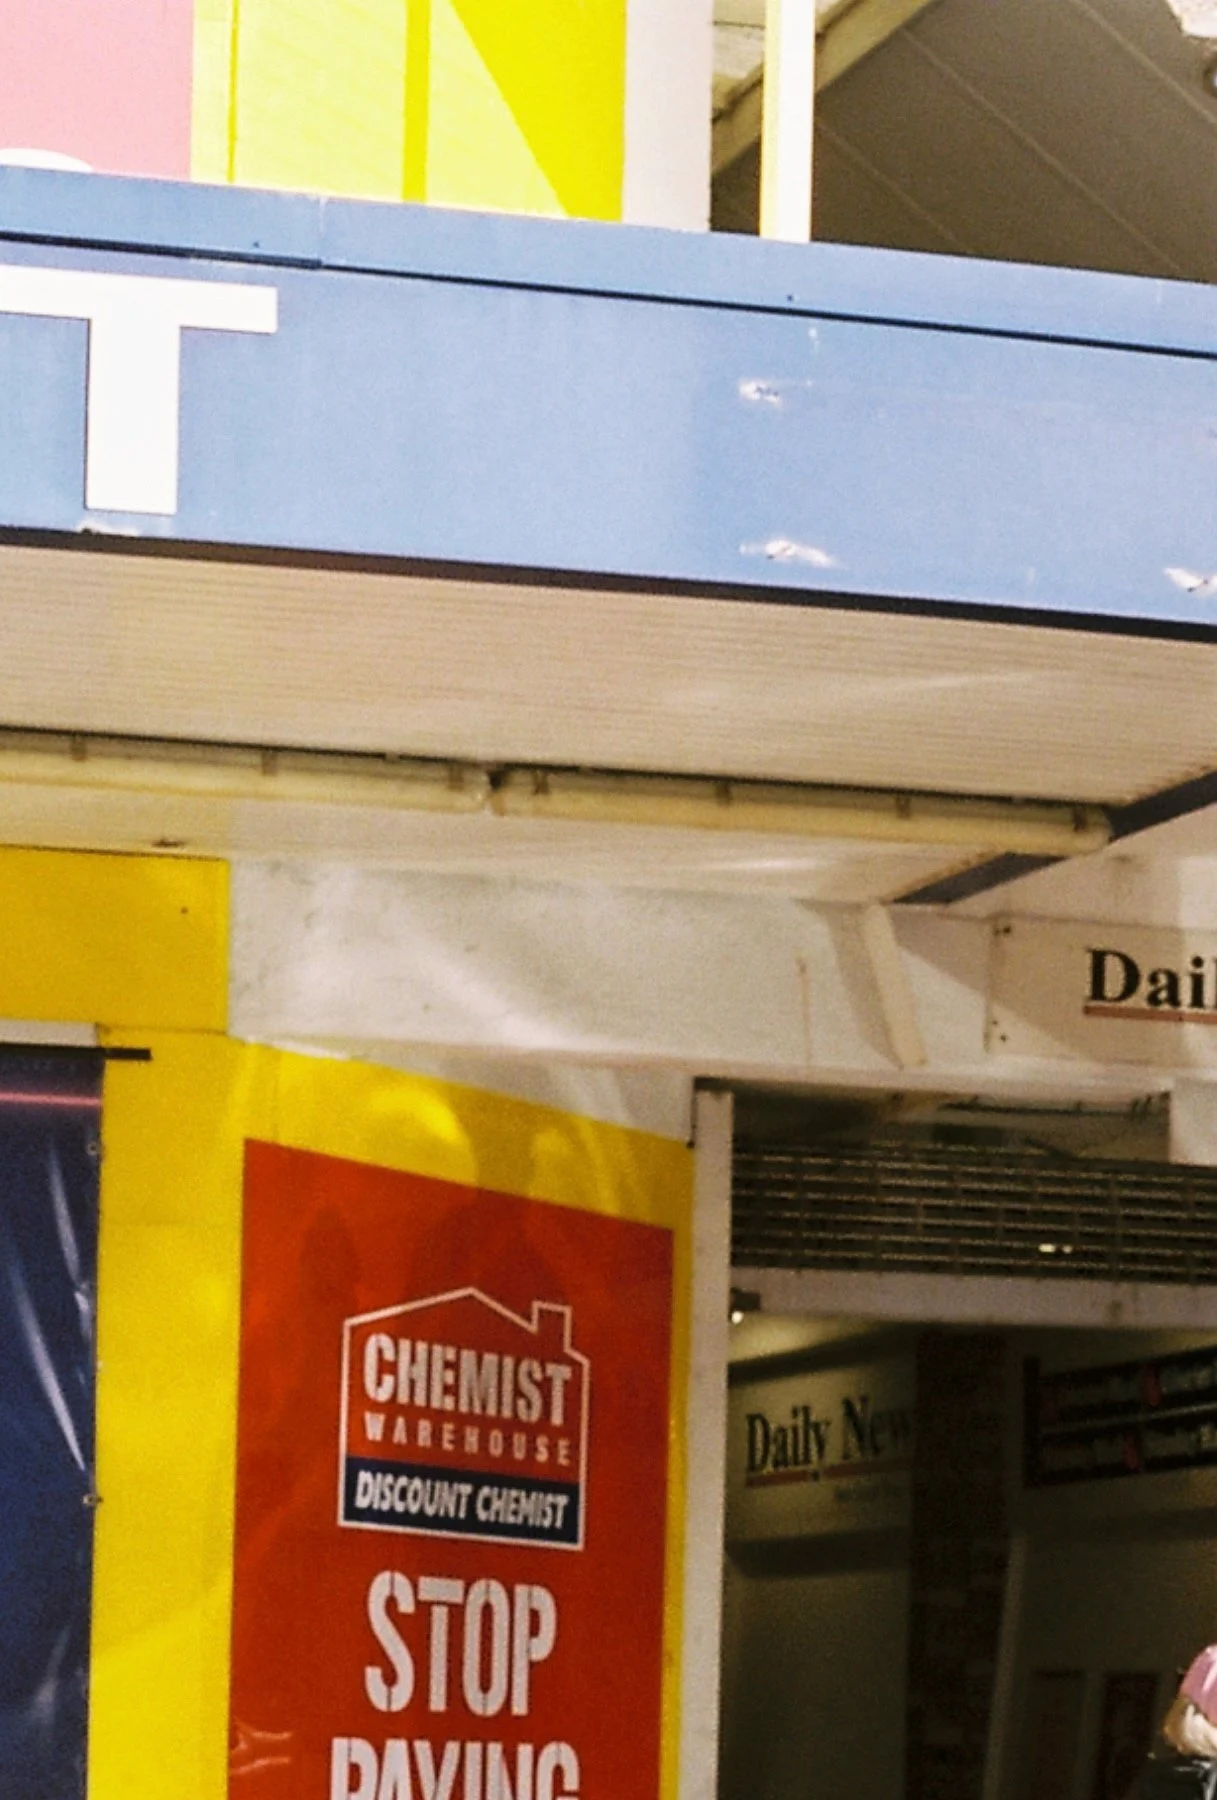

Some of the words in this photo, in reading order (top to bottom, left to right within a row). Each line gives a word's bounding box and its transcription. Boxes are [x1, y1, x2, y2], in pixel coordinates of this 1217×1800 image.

[364, 1333, 572, 1427] CHEMIST
[364, 1411, 571, 1467] WAREHOUSE
[746, 1403, 832, 1482] Daily
[355, 1470, 473, 1519] DISCOUNT
[475, 1485, 570, 1529] CHEMIST
[365, 1570, 557, 1716] STOP
